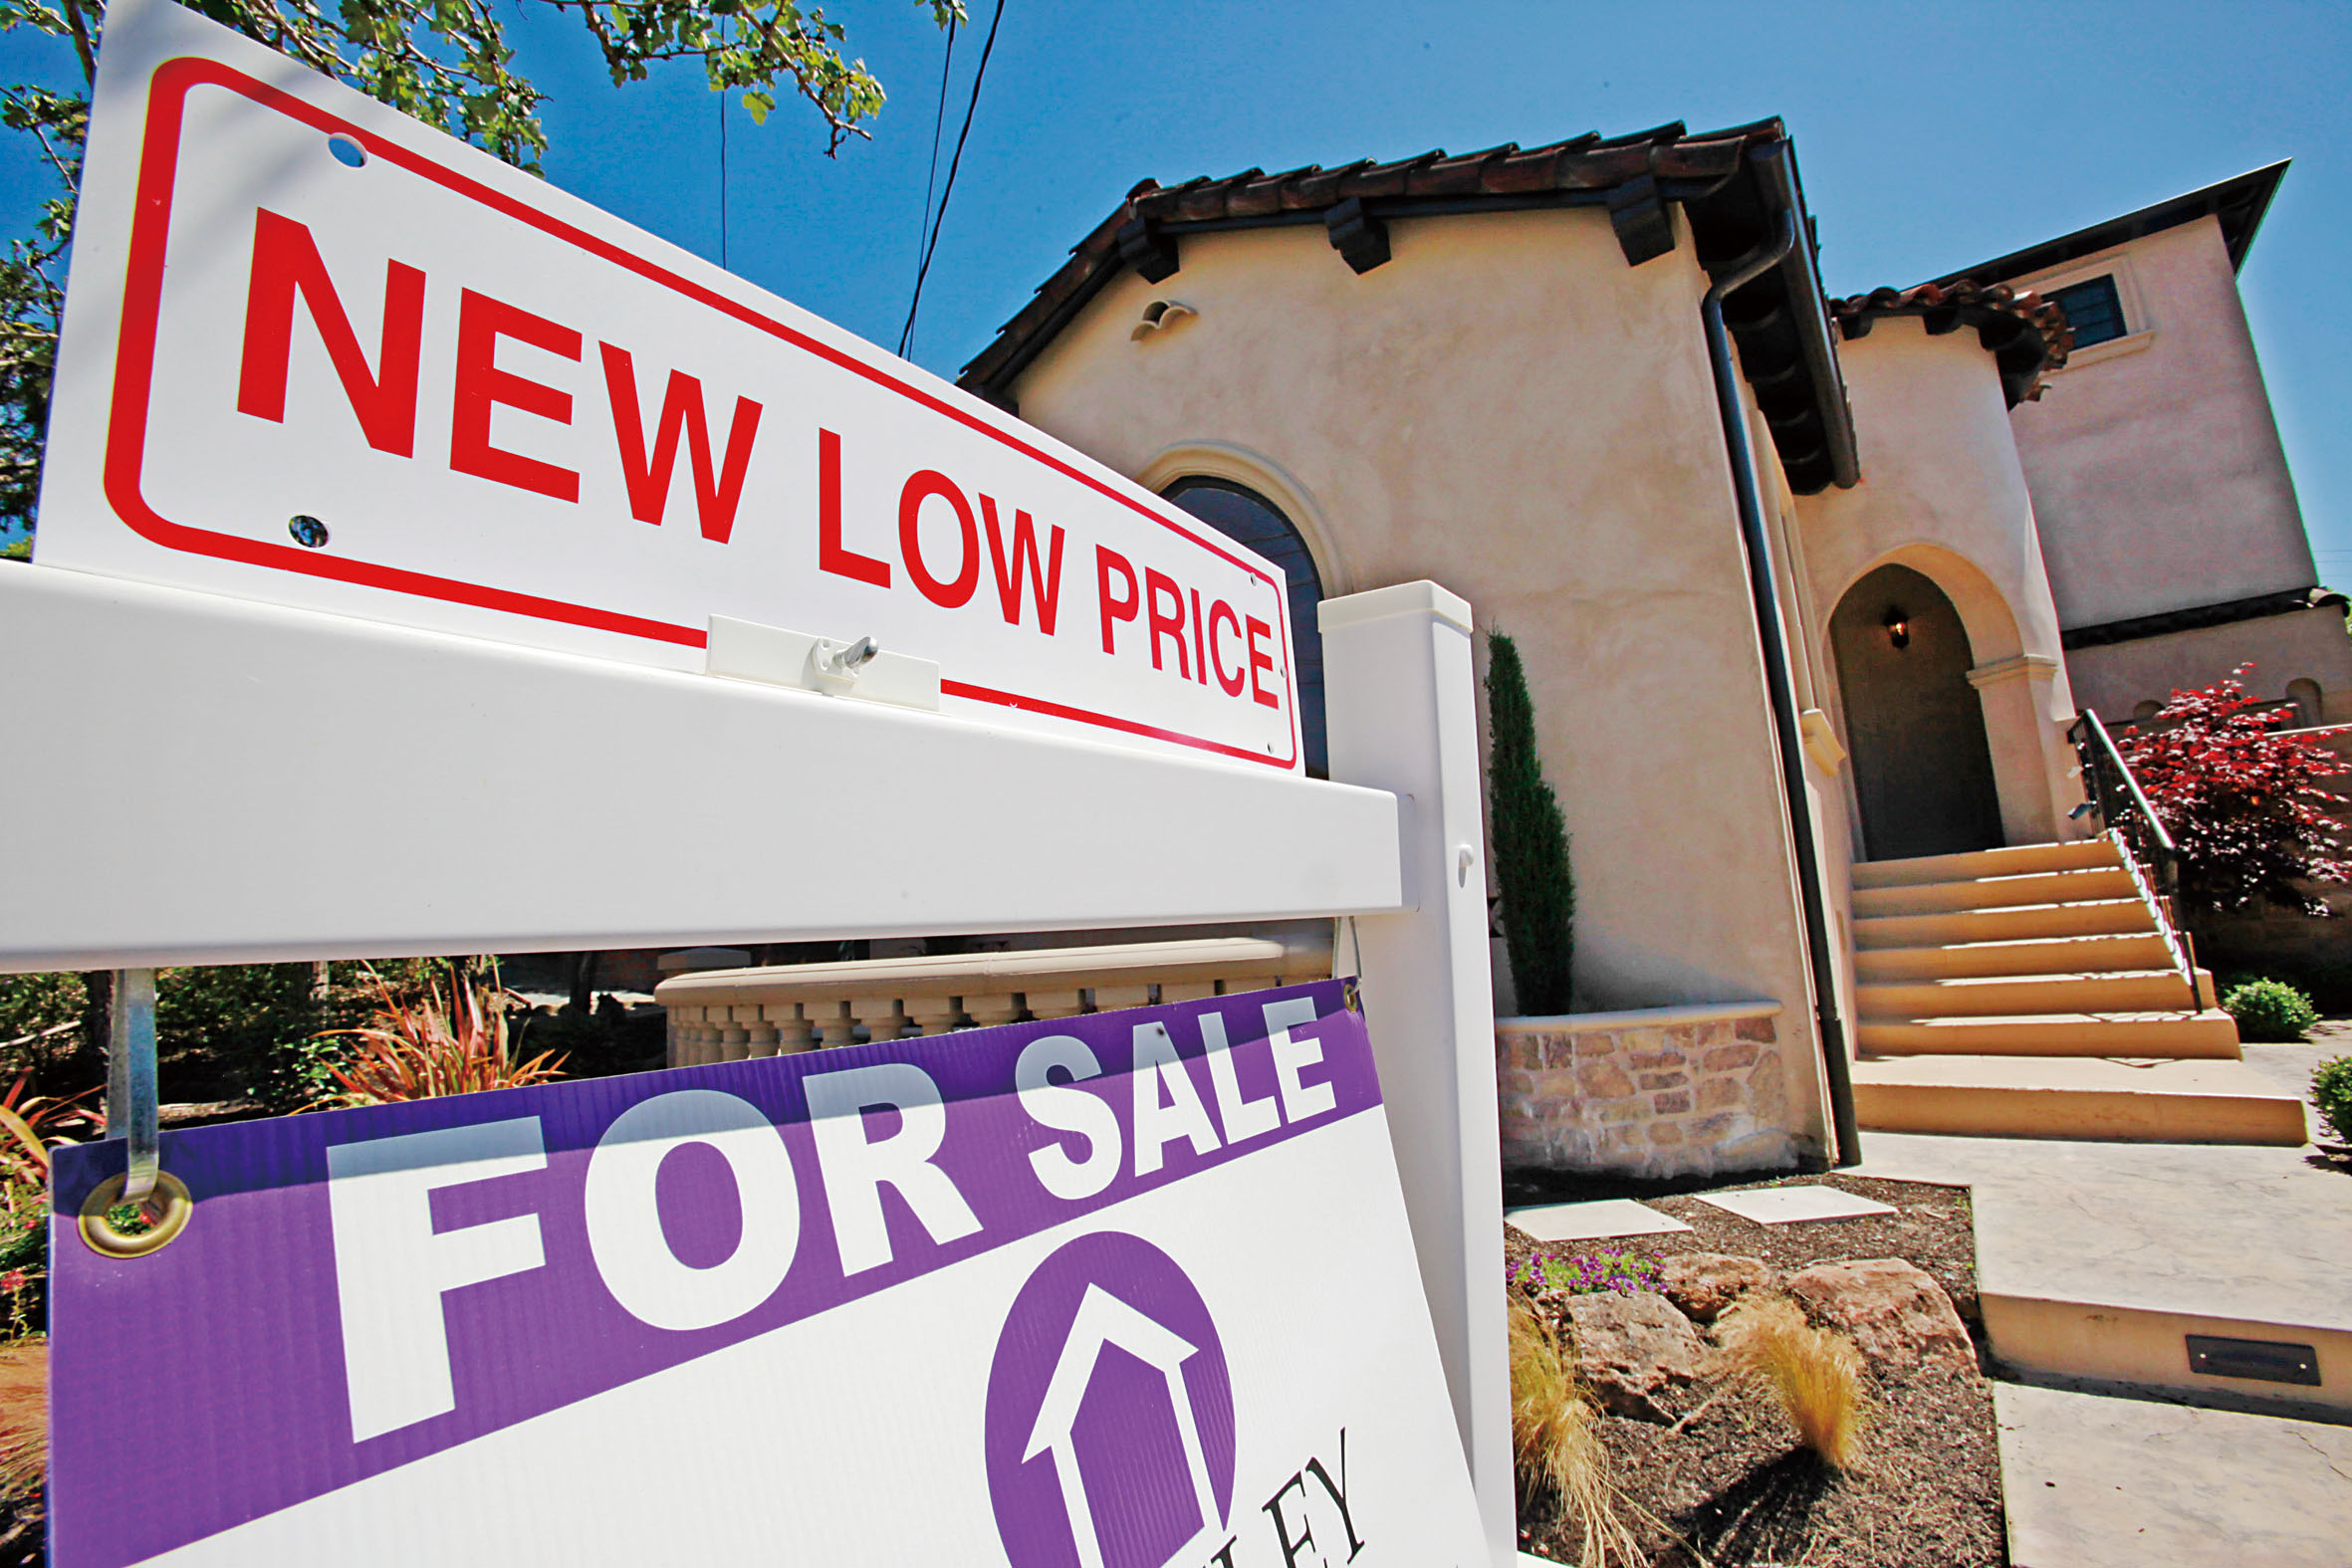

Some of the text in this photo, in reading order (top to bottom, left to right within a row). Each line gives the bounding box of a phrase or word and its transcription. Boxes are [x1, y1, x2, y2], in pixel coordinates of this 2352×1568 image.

[238, 207, 1279, 710] NEW LOW PRICE
[325, 996, 1338, 1444] FOR SALE
